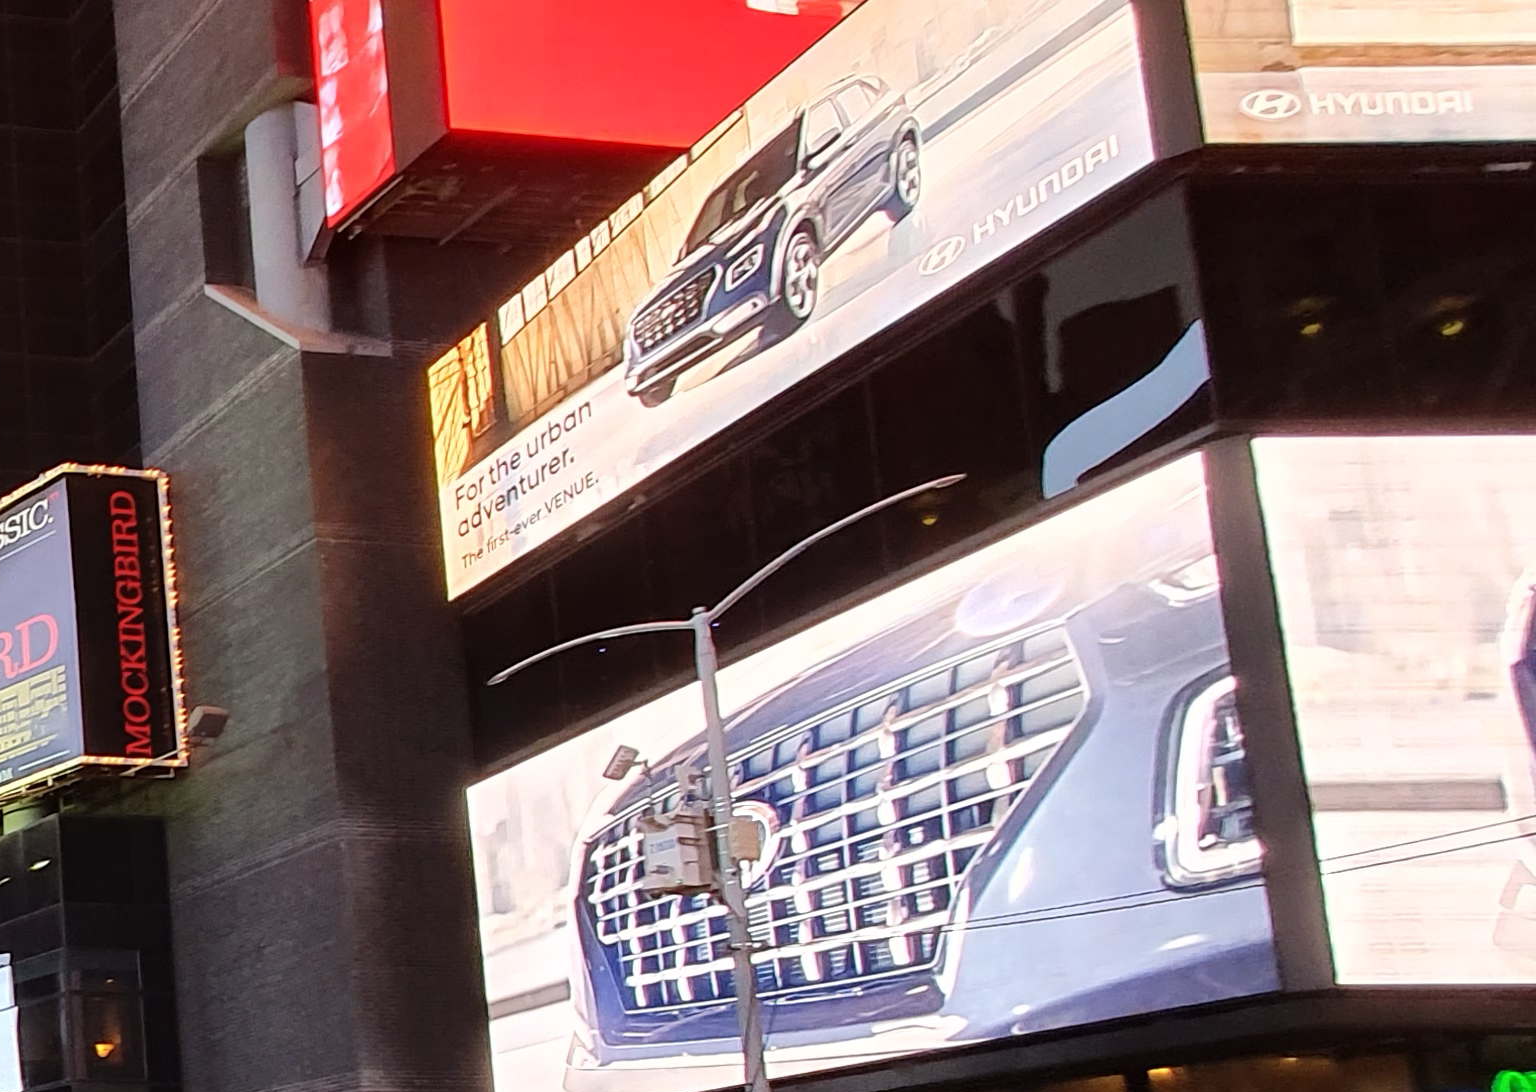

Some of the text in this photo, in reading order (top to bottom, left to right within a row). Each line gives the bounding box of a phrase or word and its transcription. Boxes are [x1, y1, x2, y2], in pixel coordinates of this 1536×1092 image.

[1308, 90, 1473, 116] HYUNDAI
[972, 134, 1121, 245] HYUNDAI
[455, 401, 593, 511] For the urban
[457, 448, 575, 537] adventurer.
[461, 472, 600, 569] The first-ever VENUE.
[109, 489, 153, 758] MOCKINGBIRD
